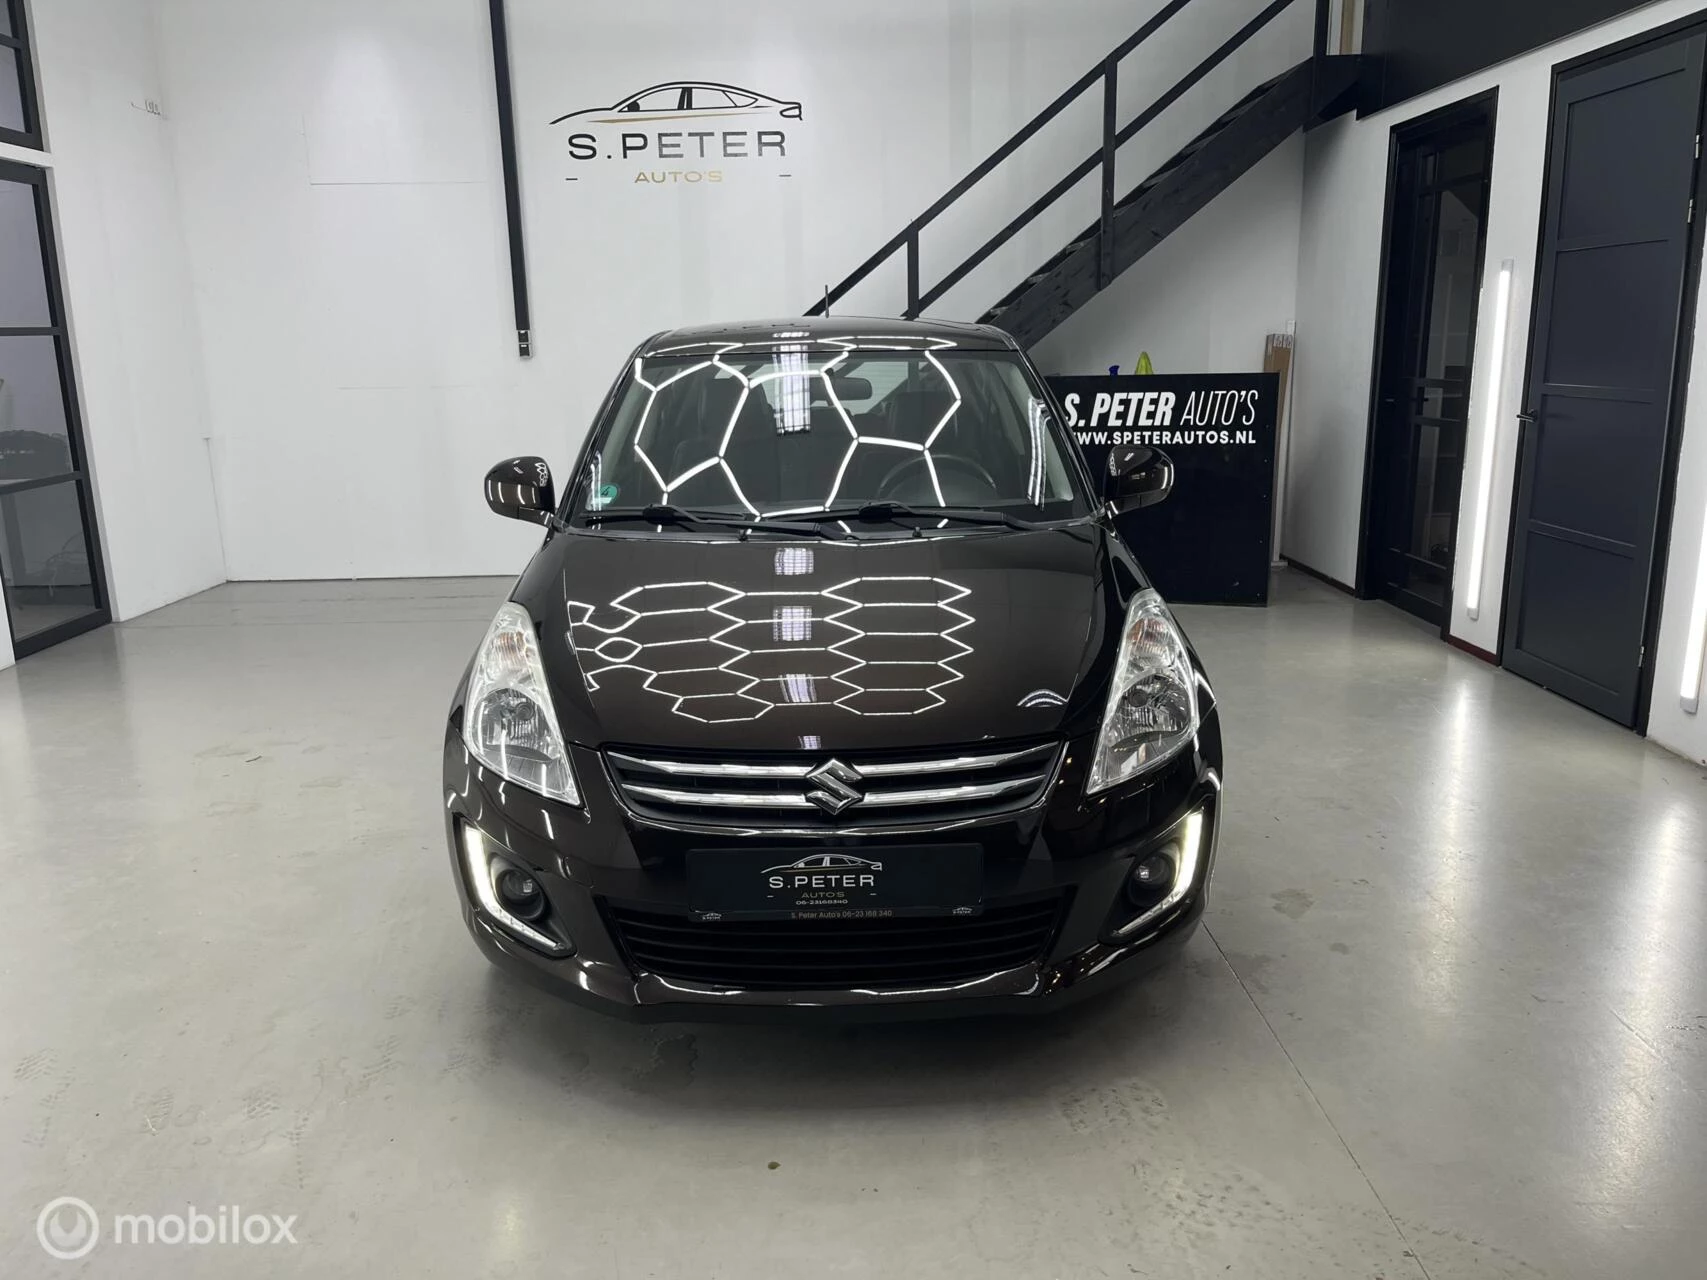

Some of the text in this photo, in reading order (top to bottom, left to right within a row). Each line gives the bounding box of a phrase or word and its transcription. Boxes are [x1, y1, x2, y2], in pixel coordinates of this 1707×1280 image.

[568, 131, 786, 160] S.PETER
[634, 170, 723, 184] AUTO'S
[1064, 390, 1258, 427] S. PETER AUTO'S
[1073, 430, 1256, 445] WW.SPETERAUTOS.NL
[768, 874, 874, 889] S.PETER
[798, 911, 817, 919] Peter
